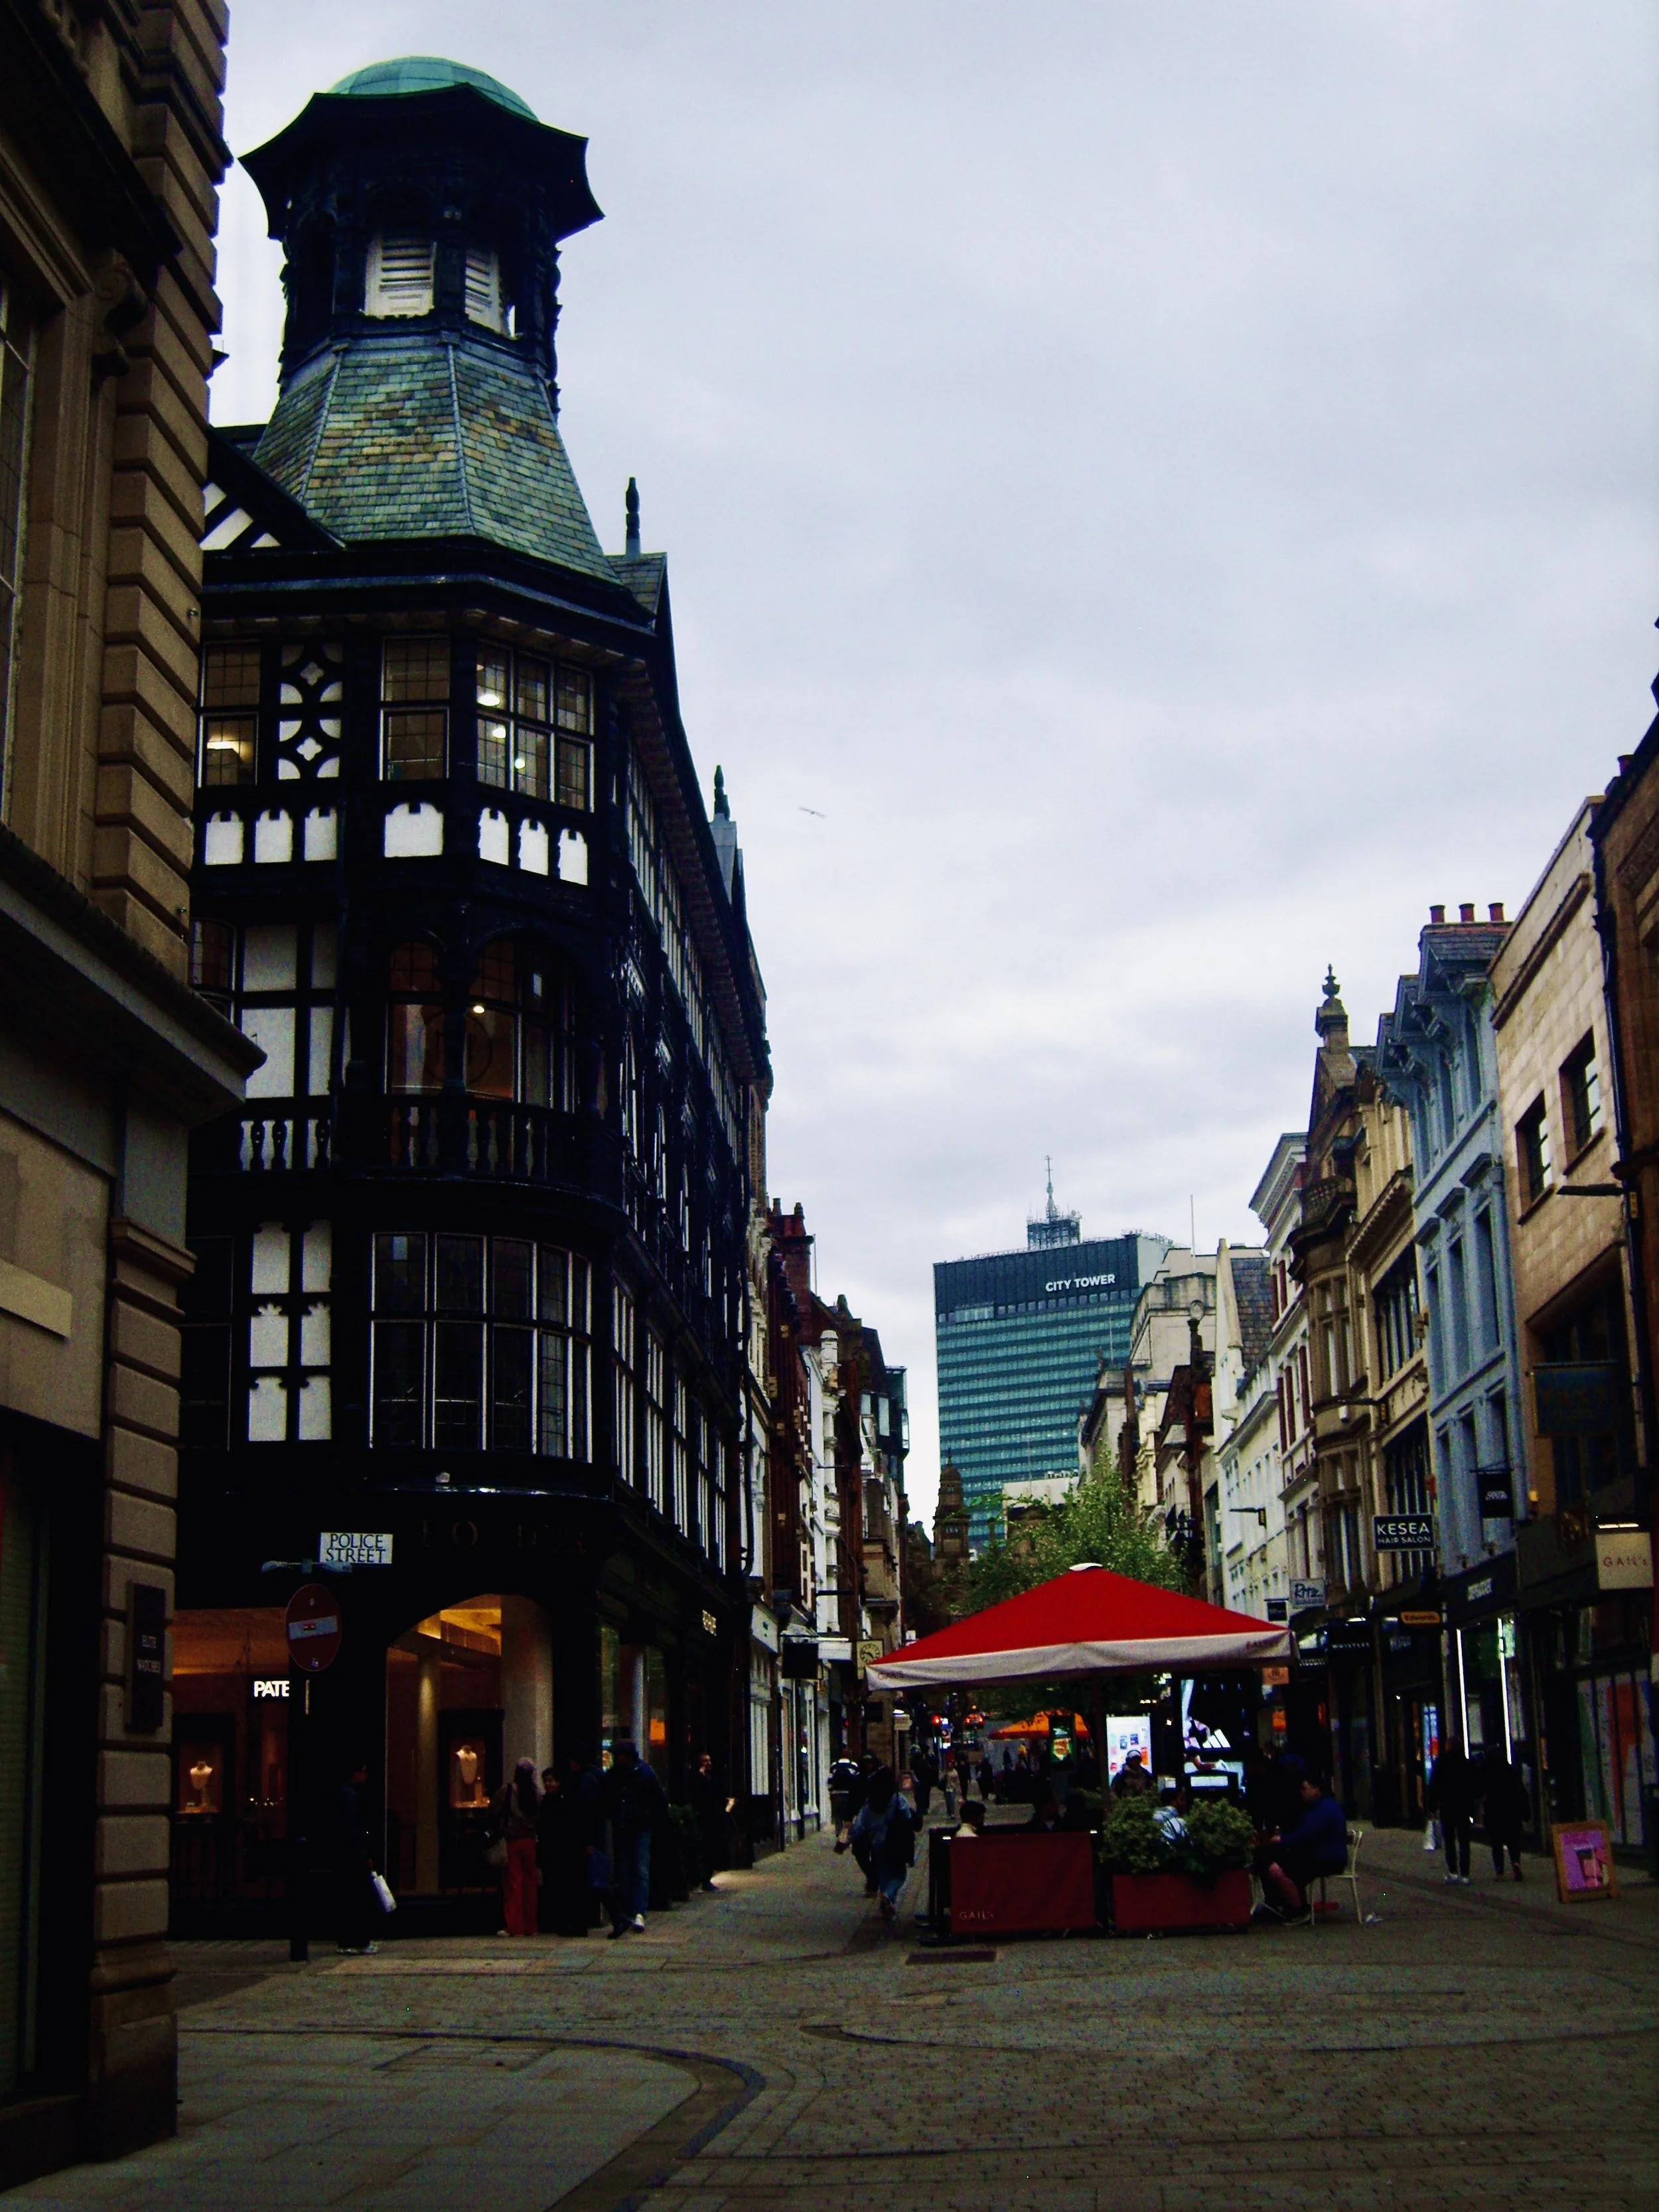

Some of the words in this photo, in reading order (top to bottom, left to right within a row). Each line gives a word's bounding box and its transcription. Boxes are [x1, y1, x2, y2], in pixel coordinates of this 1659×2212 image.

[1045, 1279, 1072, 1292] CITY
[1074, 1274, 1116, 1288] TOWER
[1377, 1522, 1430, 1535] KESEA
[330, 1533, 384, 1549] POLICE
[326, 1548, 386, 1562] STREET
